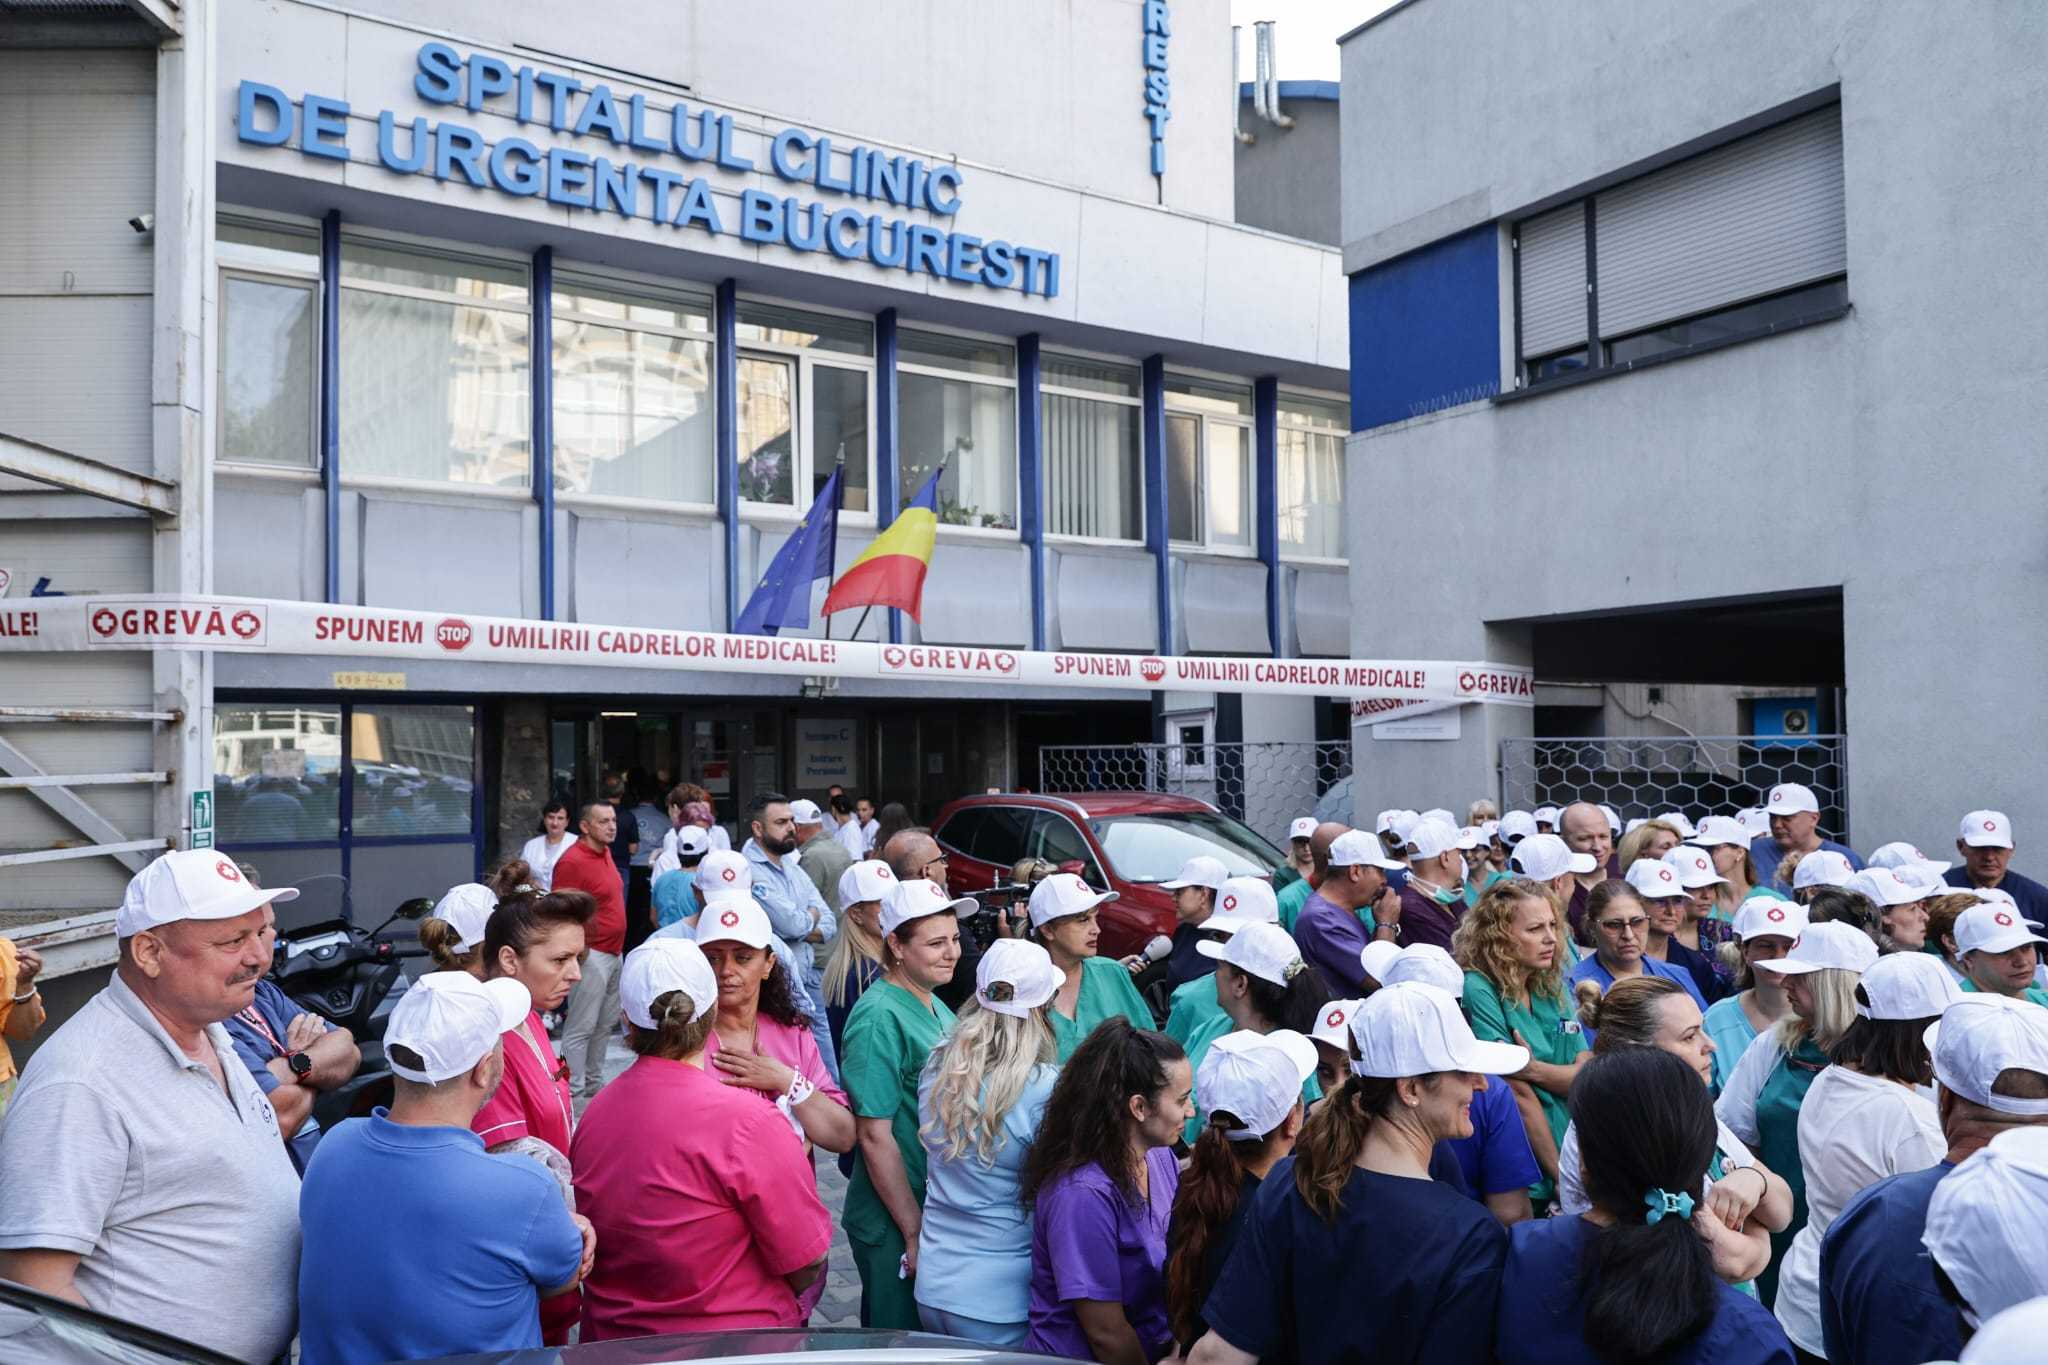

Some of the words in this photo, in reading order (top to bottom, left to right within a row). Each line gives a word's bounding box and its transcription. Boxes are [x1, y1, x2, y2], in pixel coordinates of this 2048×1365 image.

[414, 41, 753, 172] SPITALUL
[770, 128, 962, 216] CLINIC
[237, 79, 351, 160] DE
[379, 110, 722, 234] URGENTA
[741, 190, 1060, 298] BUCURESTI
[121, 606, 226, 636] GREVĂ
[315, 616, 423, 643] SPUNEM
[438, 627, 469, 640] STOP
[489, 624, 589, 651] UMILIRII
[597, 631, 717, 658] CADRELOR
[723, 640, 836, 663] MEDICALE!
[1054, 655, 1131, 676] SPUNEM
[1142, 662, 1164, 675] STOP
[1177, 660, 1249, 681] UMILIRII
[1255, 663, 1339, 684] CADRELOR
[1344, 667, 1425, 688] MEDICALE!
